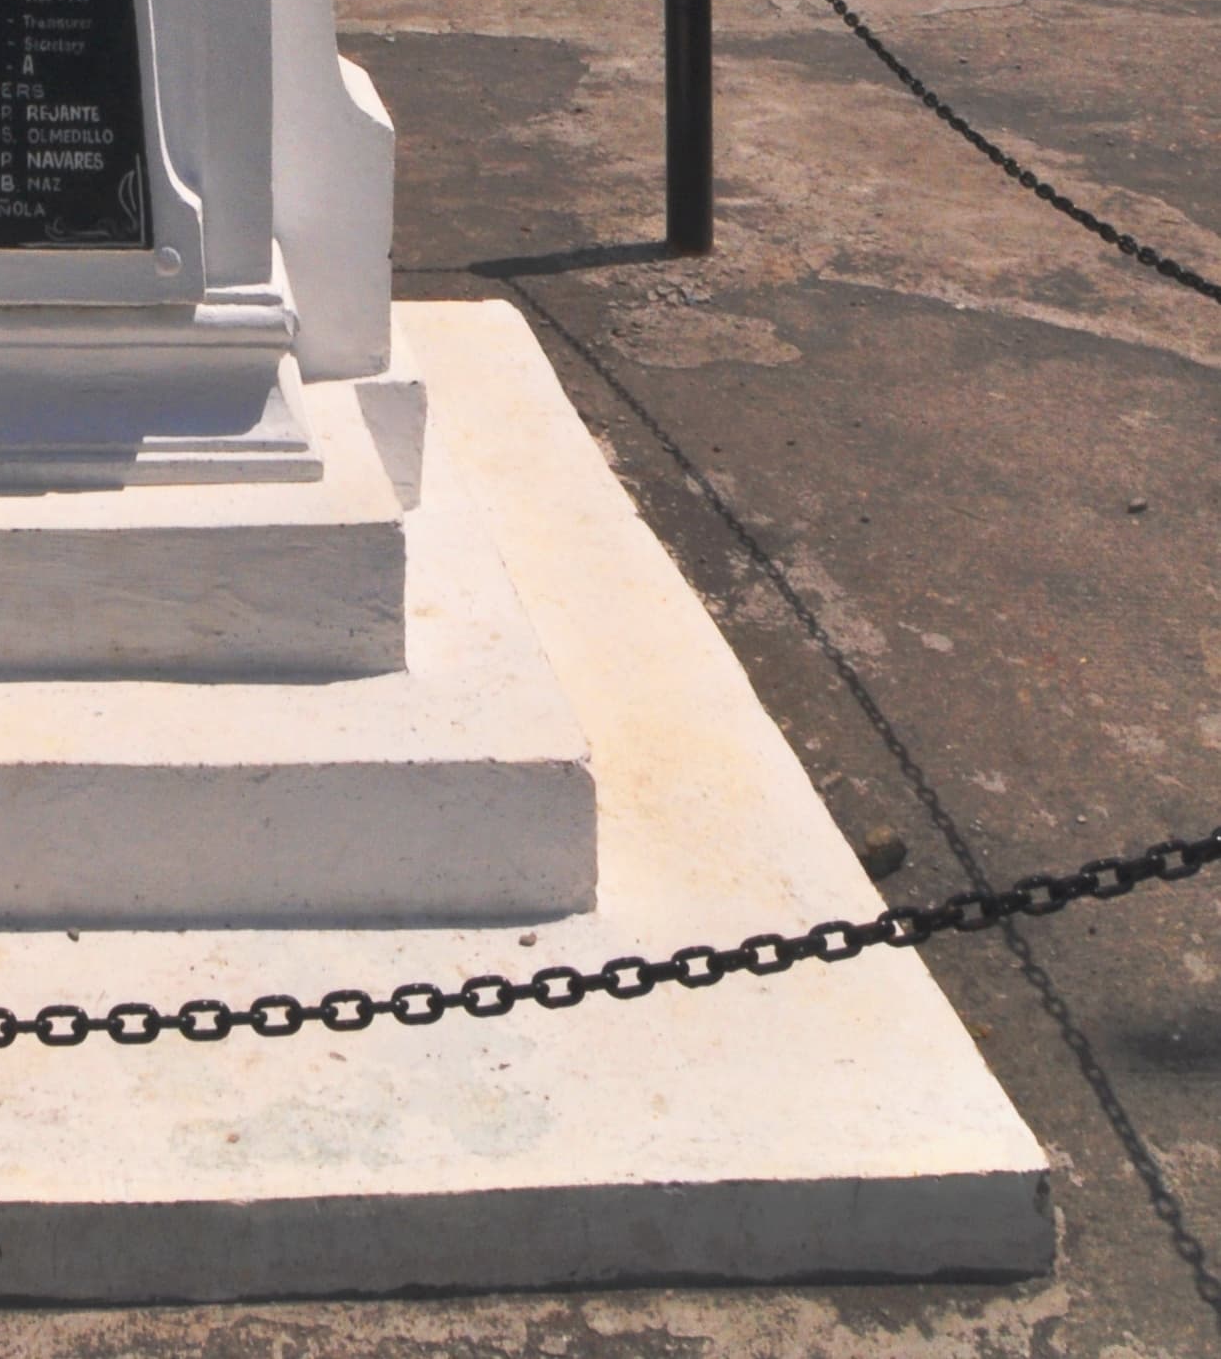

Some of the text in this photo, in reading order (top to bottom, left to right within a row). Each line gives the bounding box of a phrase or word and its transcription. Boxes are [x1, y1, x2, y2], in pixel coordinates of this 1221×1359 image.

[22, 55, 34, 75] A
[27, 129, 114, 145] OLMEDILLO
[27, 152, 104, 170] NAVARES
[27, 178, 62, 192] NAZ
